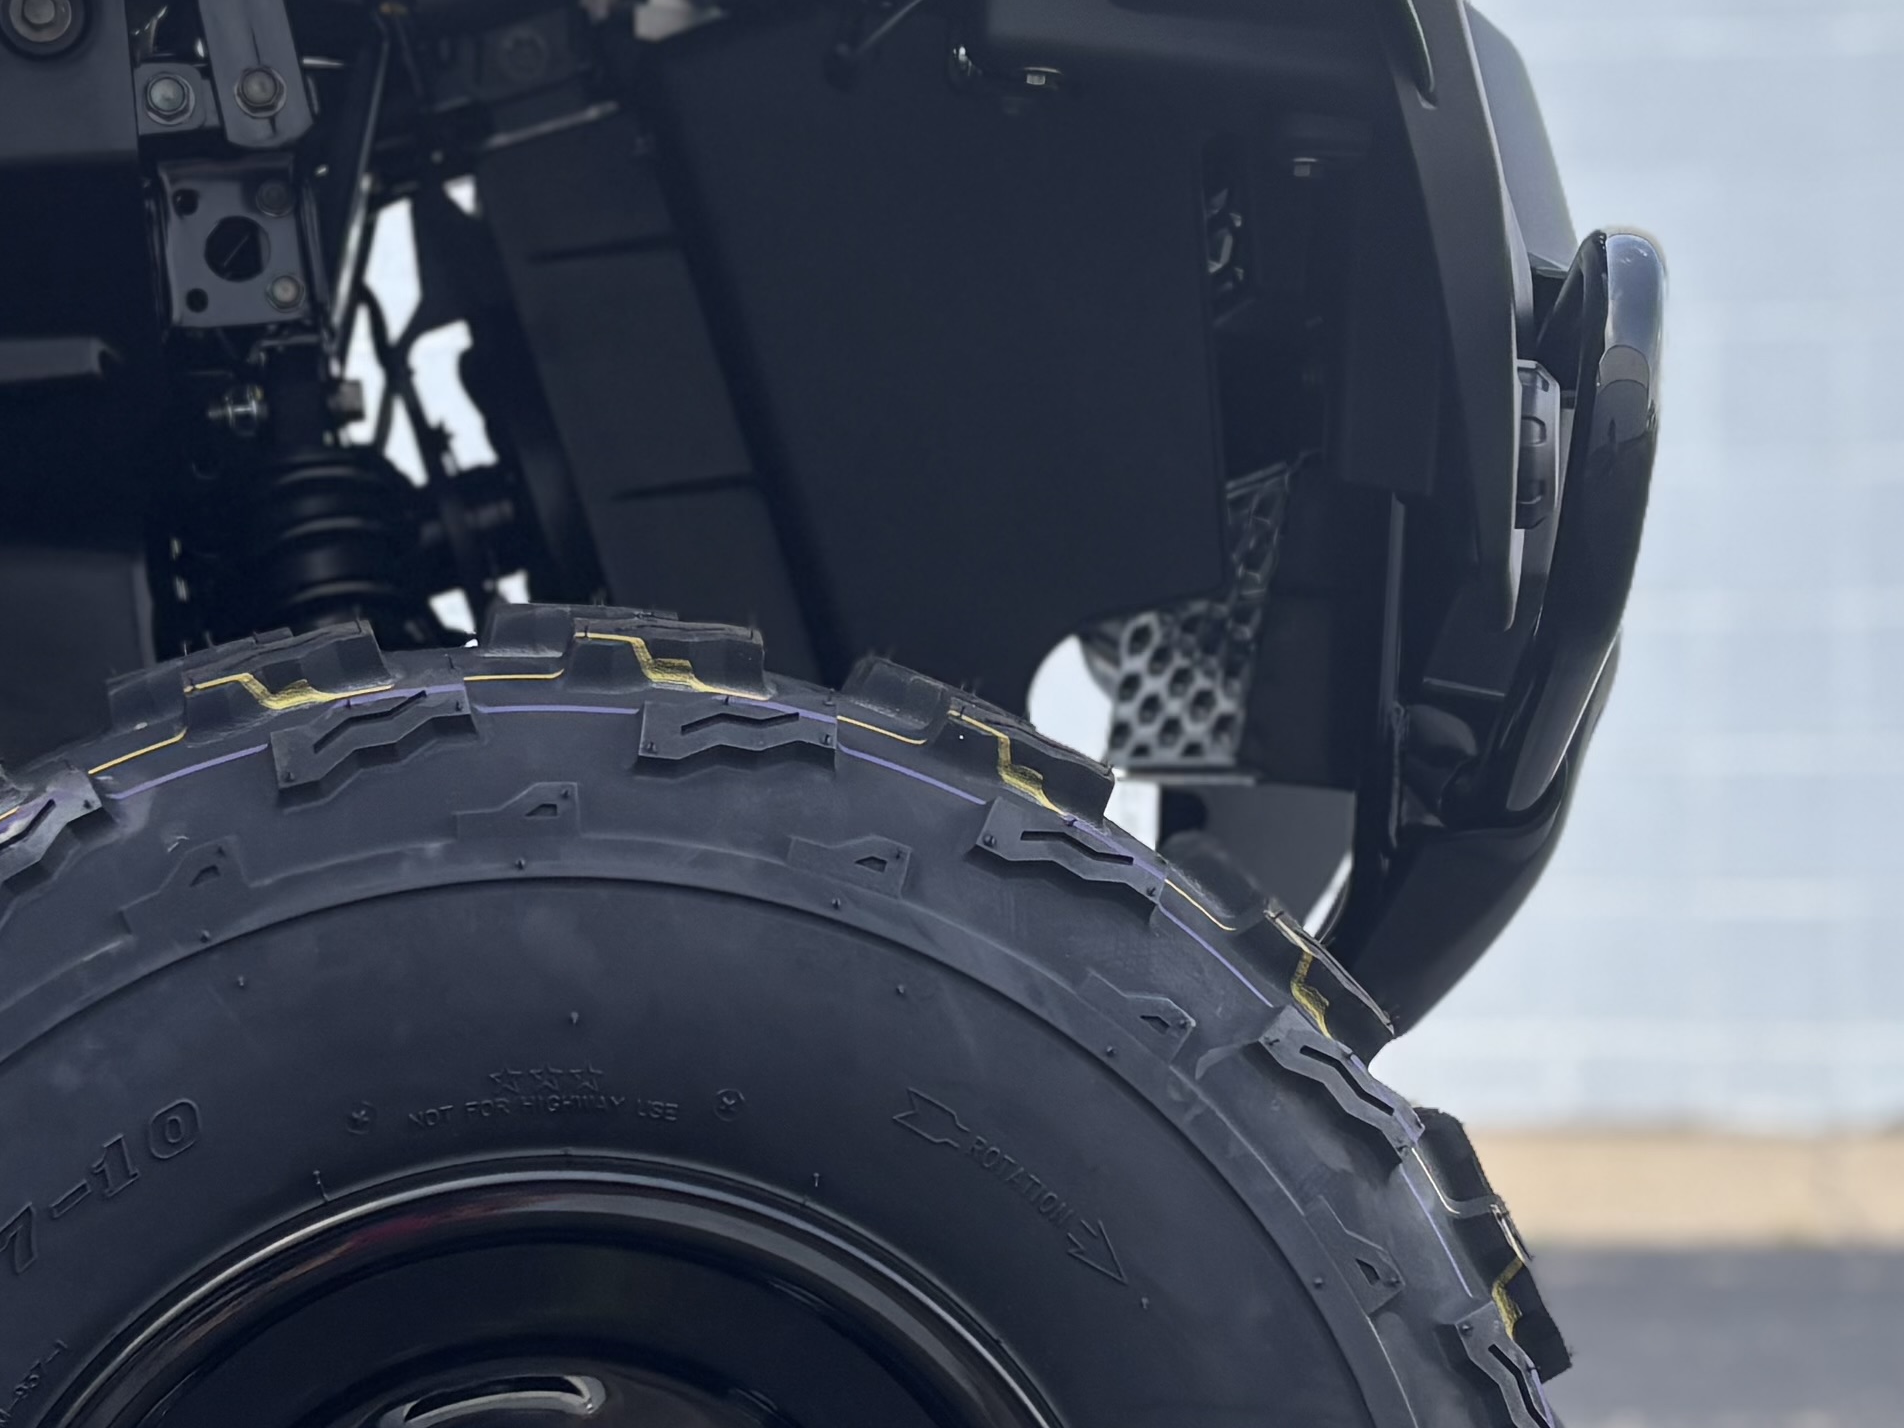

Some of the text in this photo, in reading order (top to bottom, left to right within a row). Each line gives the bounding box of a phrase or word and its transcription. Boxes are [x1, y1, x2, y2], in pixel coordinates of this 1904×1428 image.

[409, 1104, 454, 1130] NOT
[466, 1099, 508, 1118] FOR
[637, 1099, 679, 1123] USE
[968, 1136, 1073, 1228] ROTATION
